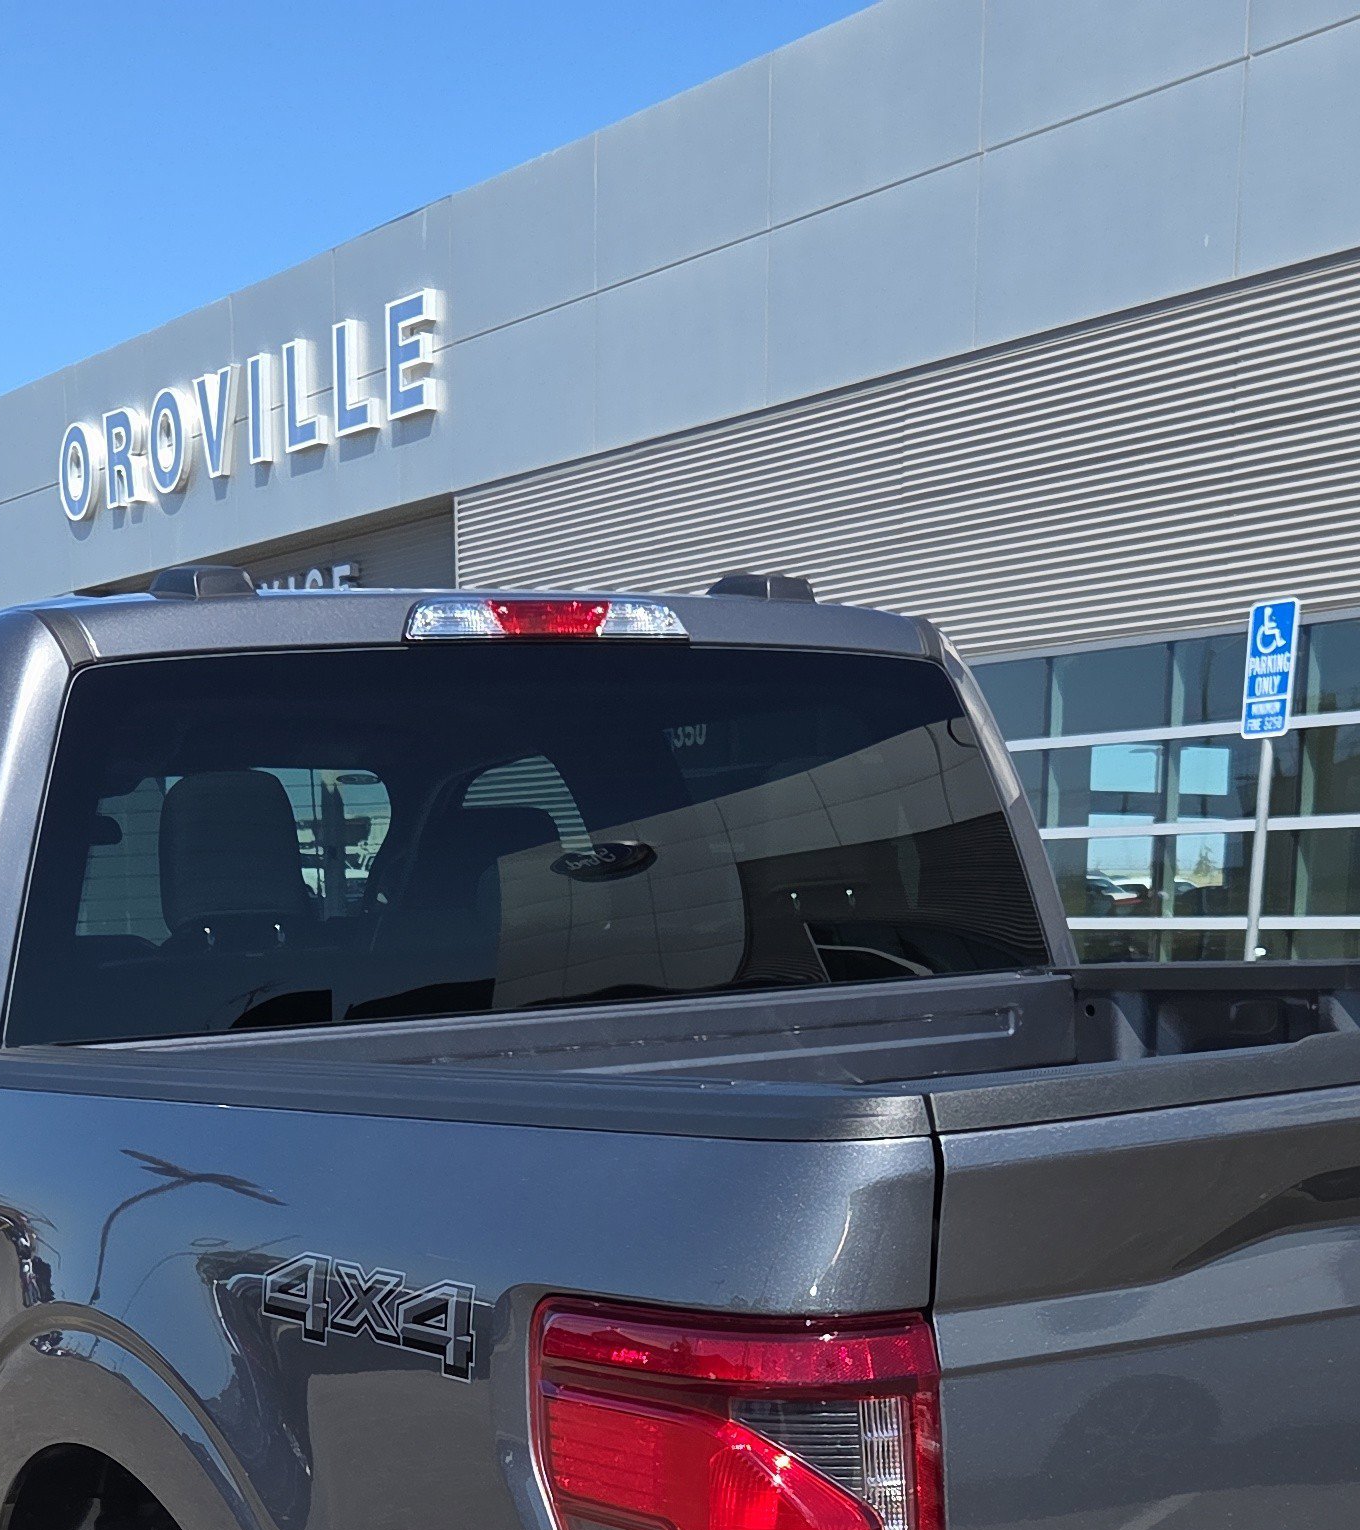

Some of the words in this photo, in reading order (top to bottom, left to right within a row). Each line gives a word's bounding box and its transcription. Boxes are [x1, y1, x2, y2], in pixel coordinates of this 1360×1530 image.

[59, 287, 444, 521] OROVILLE
[1248, 652, 1290, 676] PARKING
[1255, 675, 1281, 696] ONLY
[1246, 718, 1262, 731] FINE
